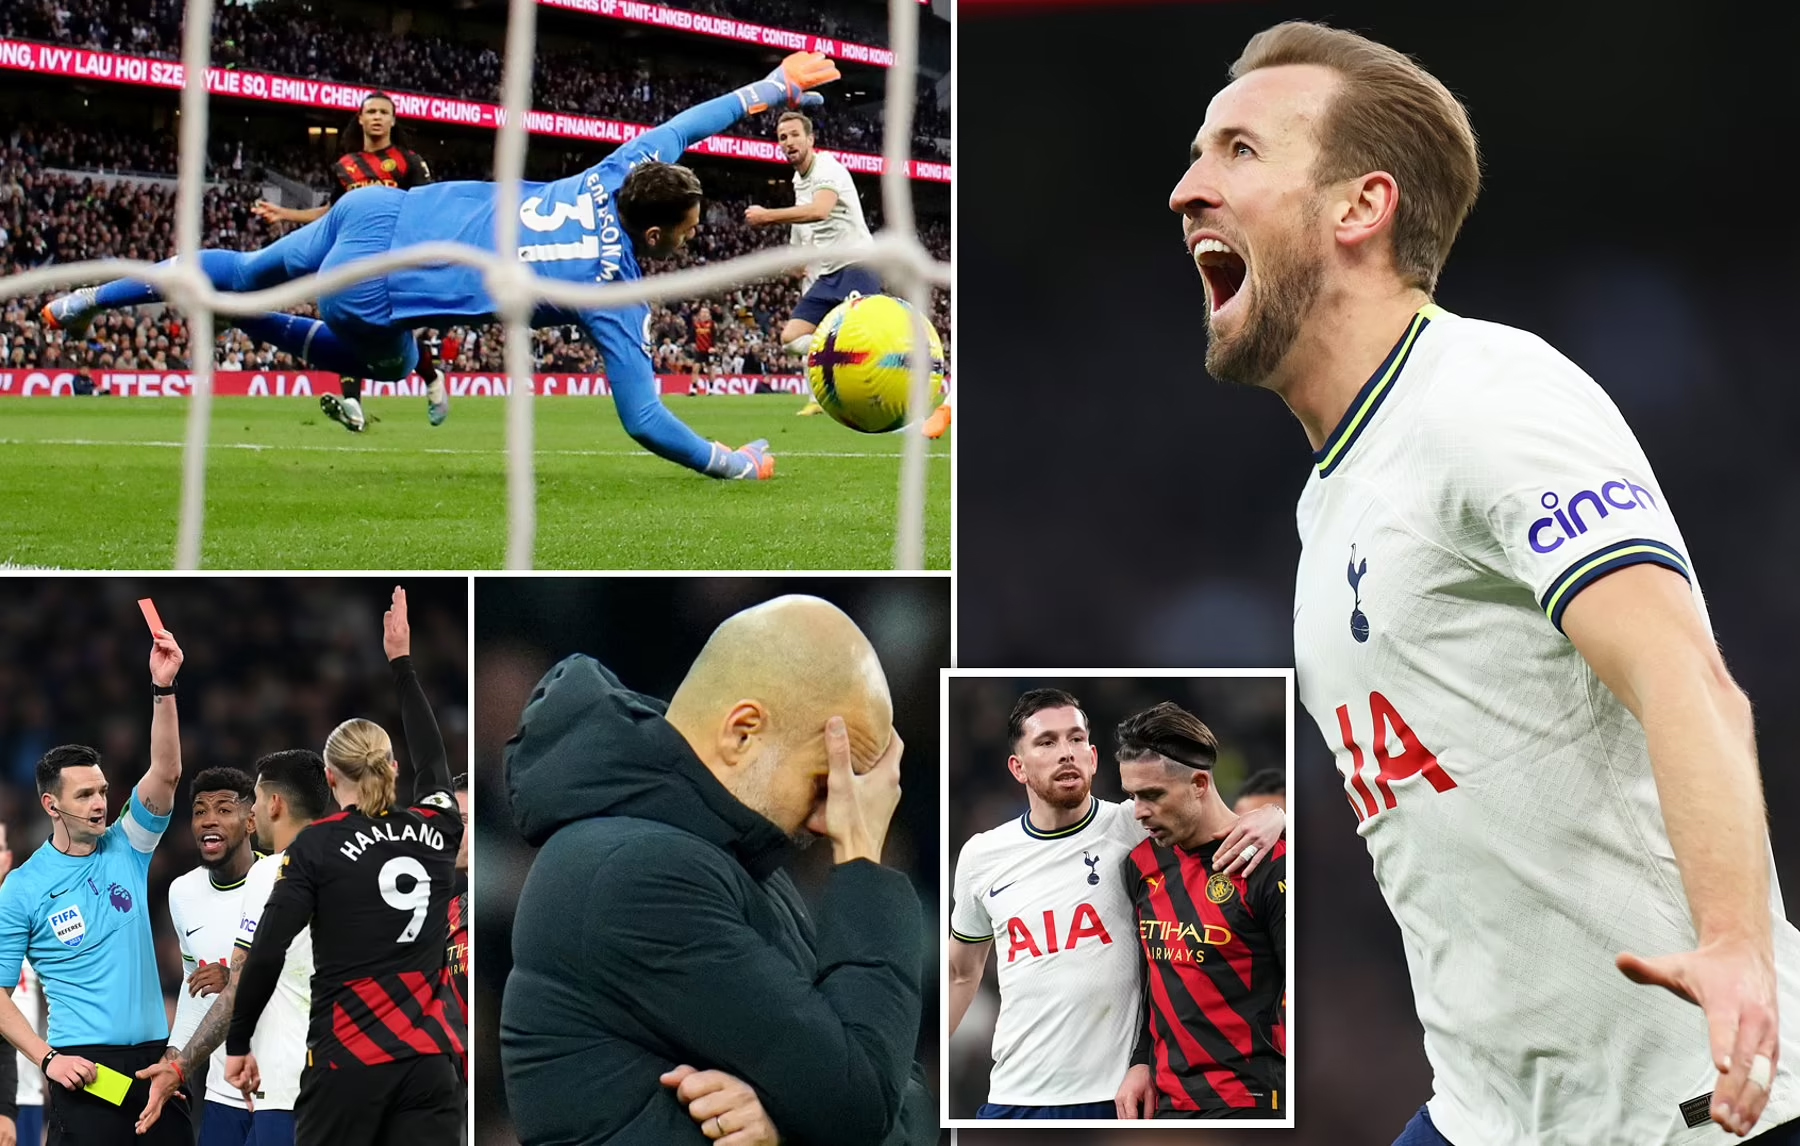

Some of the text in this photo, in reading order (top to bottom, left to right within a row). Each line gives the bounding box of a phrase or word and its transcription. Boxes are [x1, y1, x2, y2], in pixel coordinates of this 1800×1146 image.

[600, 0, 617, 14] OF
[693, 14, 736, 37] GOLDEN
[762, 27, 807, 50] CONTEST
[814, 37, 836, 55] AIA
[841, 42, 868, 61] HONG
[869, 48, 893, 66] KONG
[0, 42, 35, 70] NG,
[40, 47, 72, 72] IVY
[75, 51, 112, 77] LAU
[115, 57, 148, 81] HOI
[242, 74, 269, 99] SO,
[271, 77, 319, 102] EMILY
[321, 85, 373, 107] CHEN
[389, 93, 430, 117] ENRY
[431, 100, 481, 123] CHUNG
[494, 107, 554, 132] WNING
[555, 116, 622, 141] FINANCIAL
[841, 152, 884, 173] CONTEST
[916, 162, 942, 180] HONG
[518, 192, 600, 263] 31
[247, 374, 313, 397] AIA
[1528, 478, 1660, 554] cinch
[1336, 691, 1458, 823] IA
[339, 823, 445, 862] HAALAND
[51, 909, 78, 926] FIFA
[240, 911, 257, 933] inc
[378, 856, 432, 943] 9
[57, 922, 83, 937] REFEREE
[1007, 902, 1113, 962] AIA
[1139, 920, 1232, 946] ETIHAD
[1146, 946, 1205, 963] AIRWAYS
